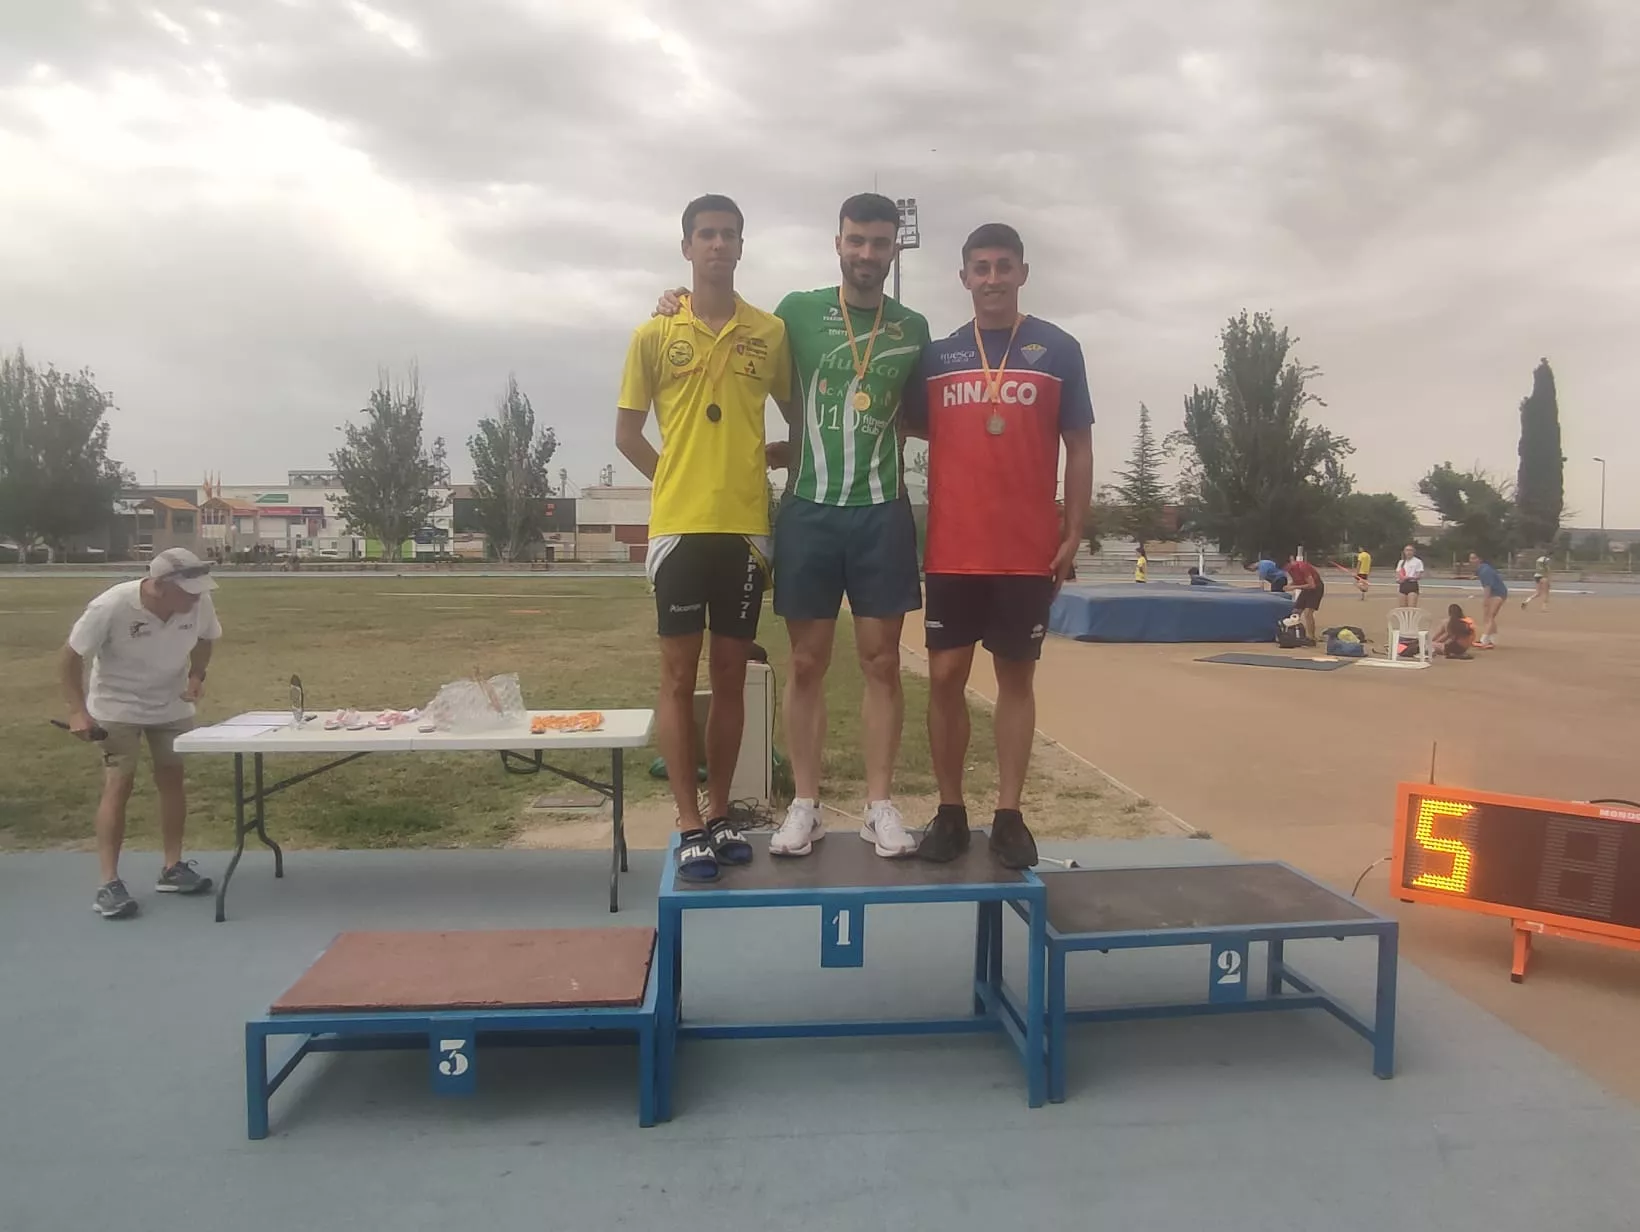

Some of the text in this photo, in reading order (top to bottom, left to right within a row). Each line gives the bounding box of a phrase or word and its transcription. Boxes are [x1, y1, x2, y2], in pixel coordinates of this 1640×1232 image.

[943, 380, 1037, 407] HINACO
[680, 845, 716, 862] FILA
[715, 829, 747, 844] FILA
[1412, 799, 1477, 893] 5
[832, 909, 851, 946] 1
[1217, 950, 1241, 985] 2
[439, 1039, 468, 1076] 3
